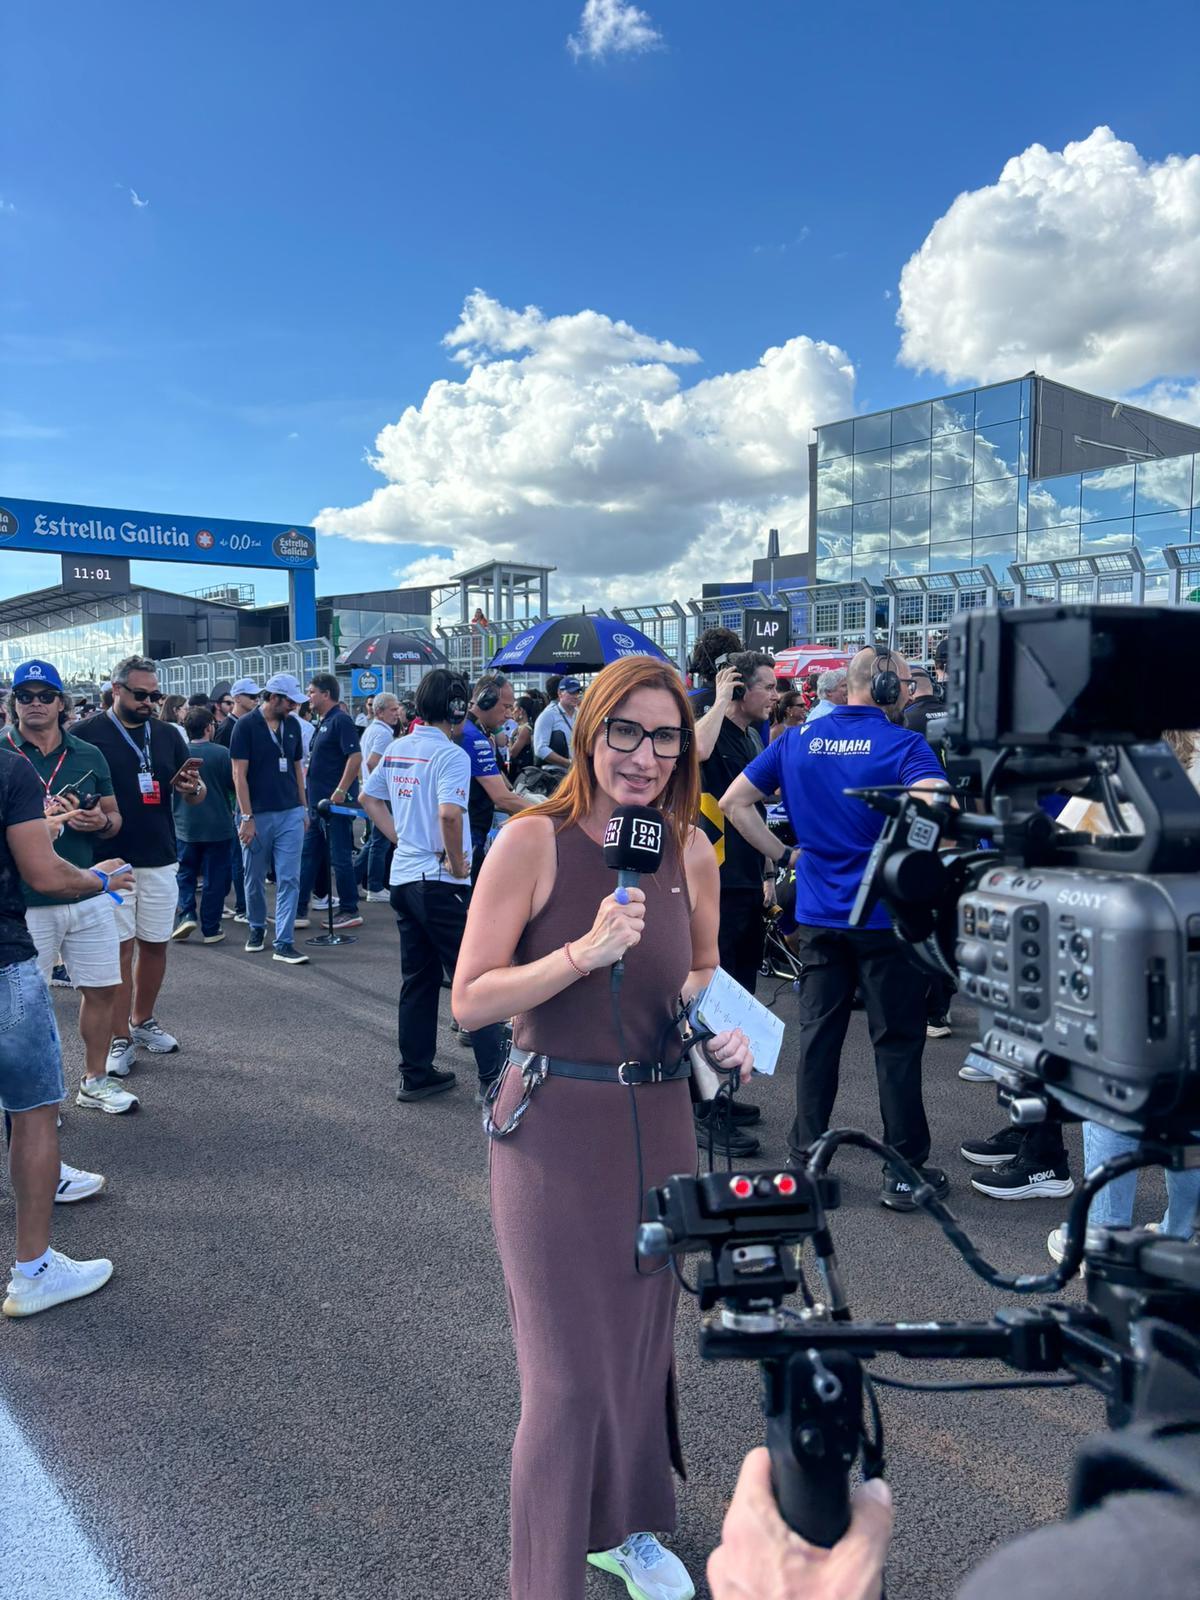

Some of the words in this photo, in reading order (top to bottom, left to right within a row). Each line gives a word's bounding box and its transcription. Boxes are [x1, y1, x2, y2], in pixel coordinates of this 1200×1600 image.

[33, 513, 116, 541] Estrella
[120, 521, 191, 548] Galicia
[280, 537, 308, 549] Estrella
[280, 545, 307, 556] Galicia
[73, 567, 112, 581] 11:01
[756, 620, 779, 637] LAP
[824, 739, 872, 752] YAMAHA
[640, 823, 656, 837] DA
[638, 834, 655, 848] ZN
[1057, 889, 1107, 910] SONY
[1028, 1169, 1056, 1184] HOKA
